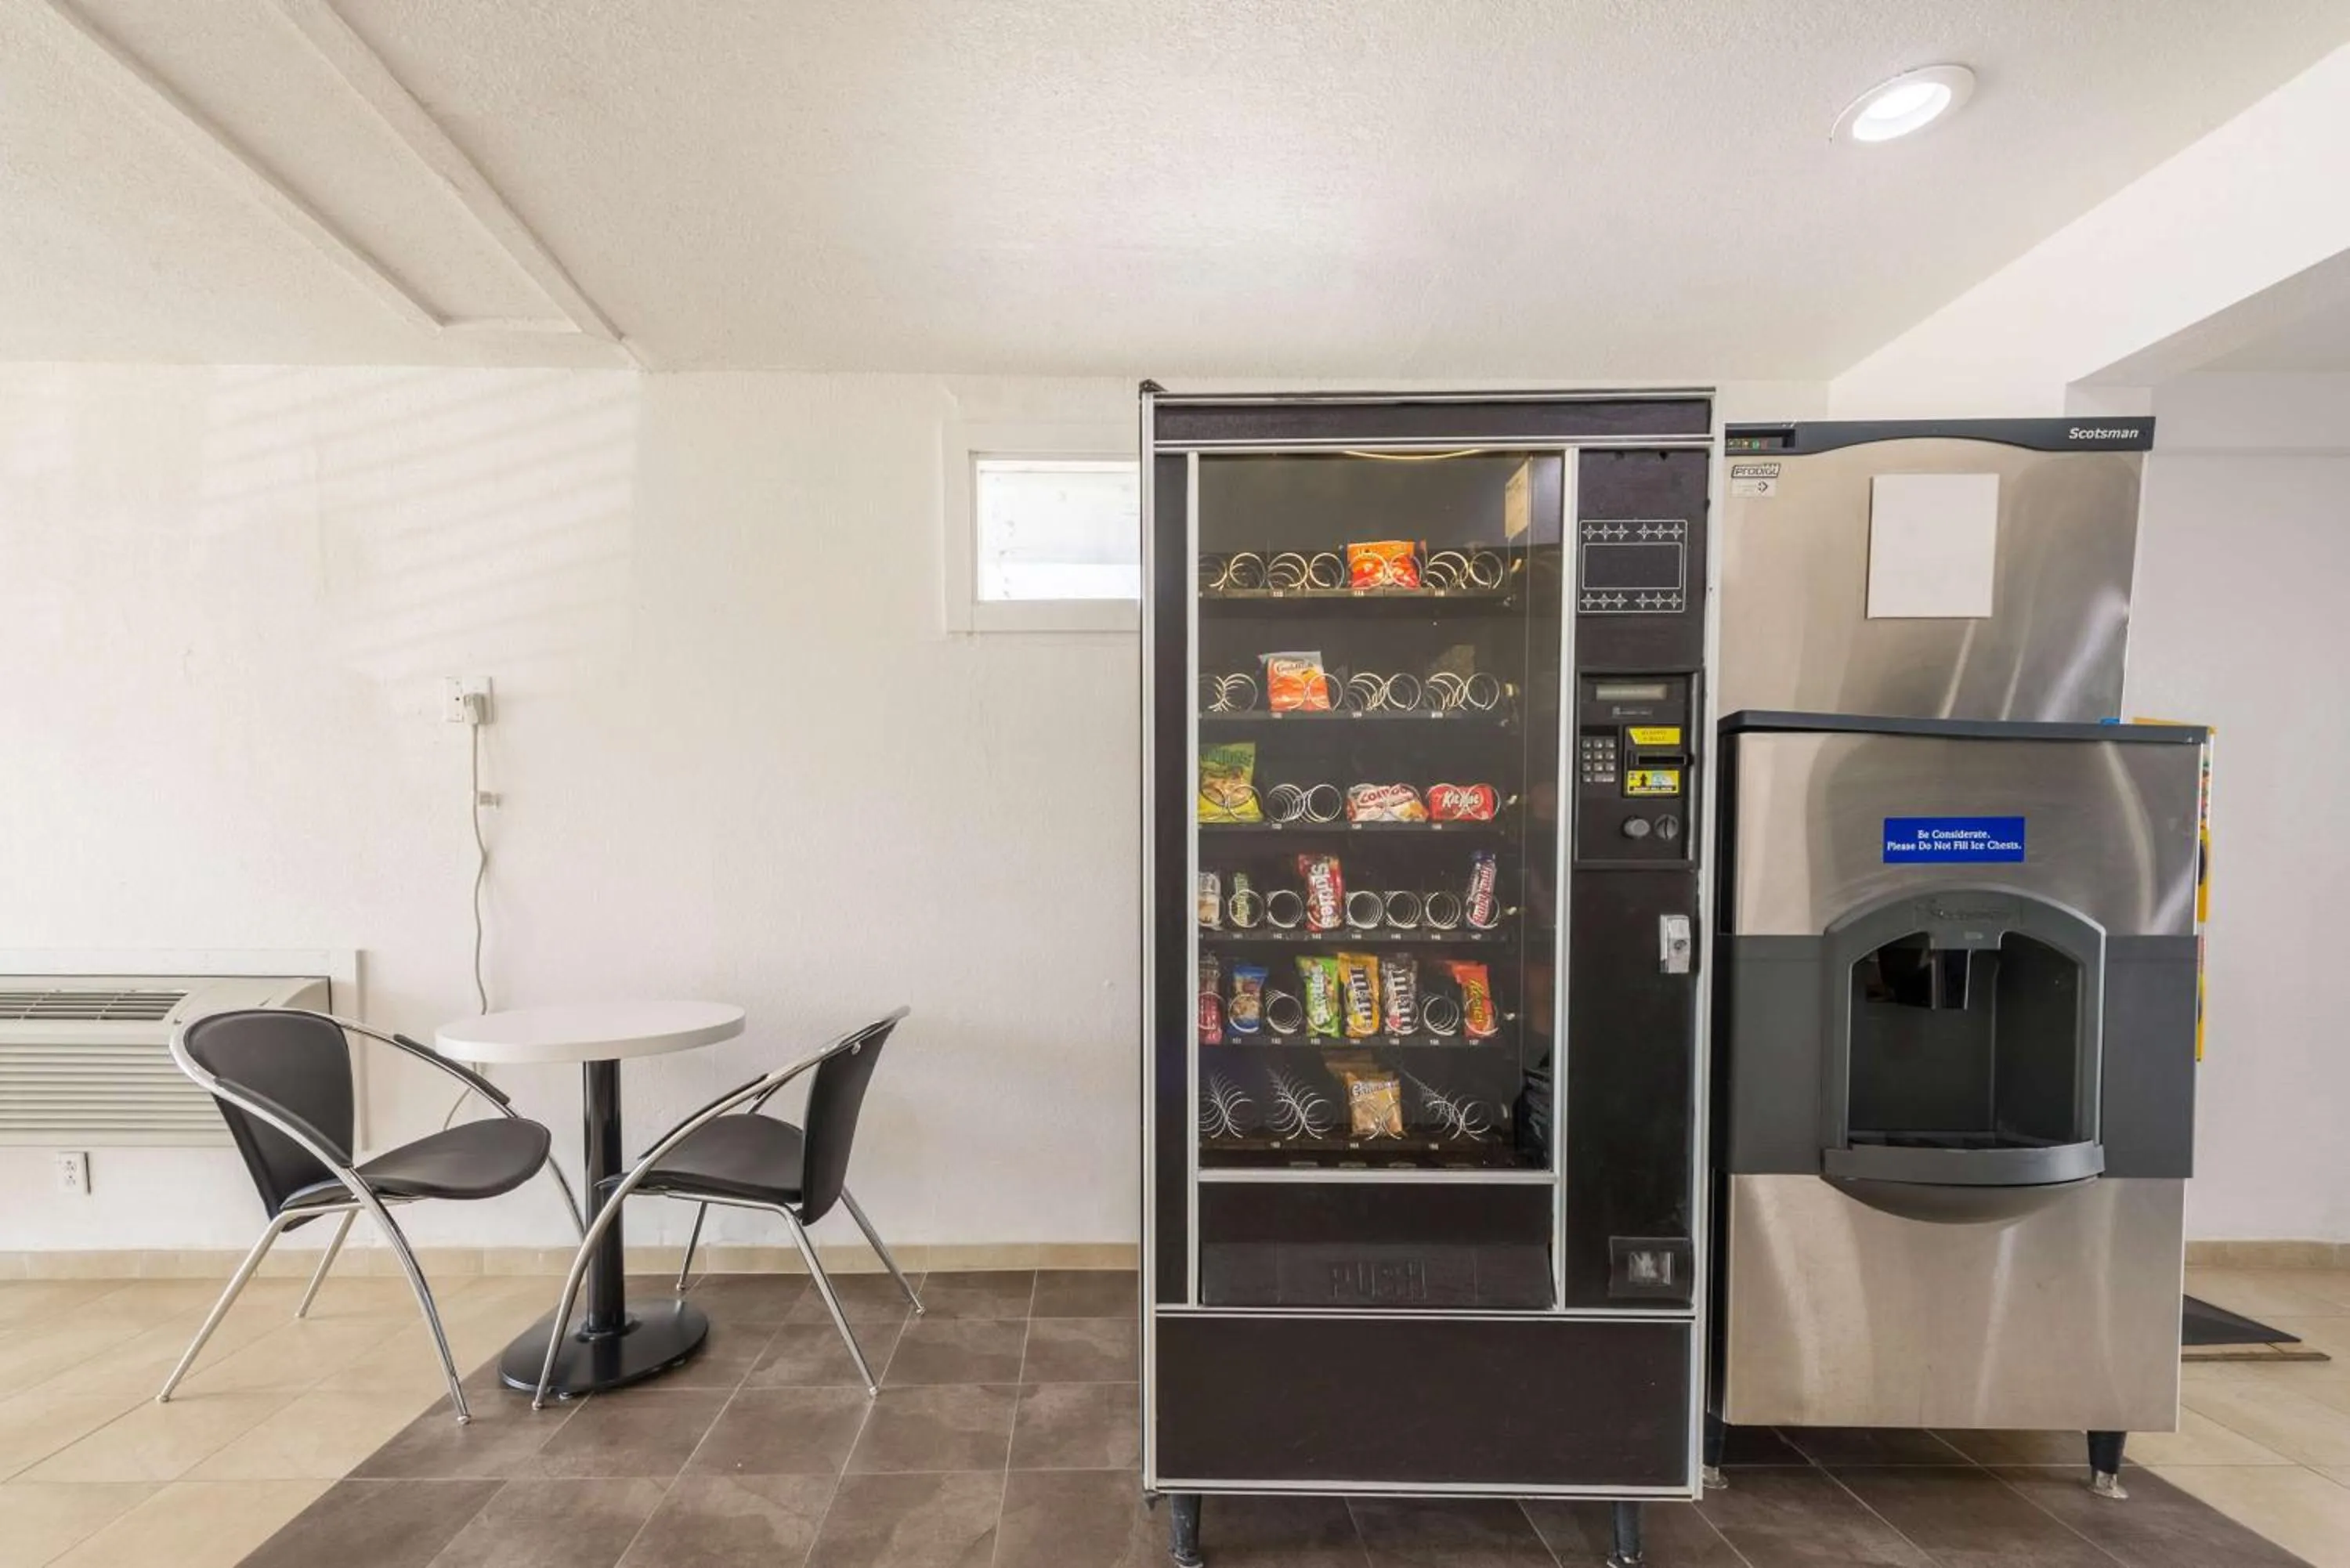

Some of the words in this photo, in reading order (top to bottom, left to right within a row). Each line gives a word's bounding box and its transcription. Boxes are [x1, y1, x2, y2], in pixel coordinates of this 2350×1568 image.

[2068, 427, 2139, 439] Scotsman
[1918, 829, 1929, 839] Be
[1932, 829, 1990, 839] Considerate.
[1887, 841, 1916, 851] Please
[1919, 841, 1932, 851] Do
[1934, 841, 1952, 851] Not
[1954, 841, 1969, 851] Fill
[1971, 841, 1985, 850] Ice
[1987, 840, 2022, 850] Chests.
